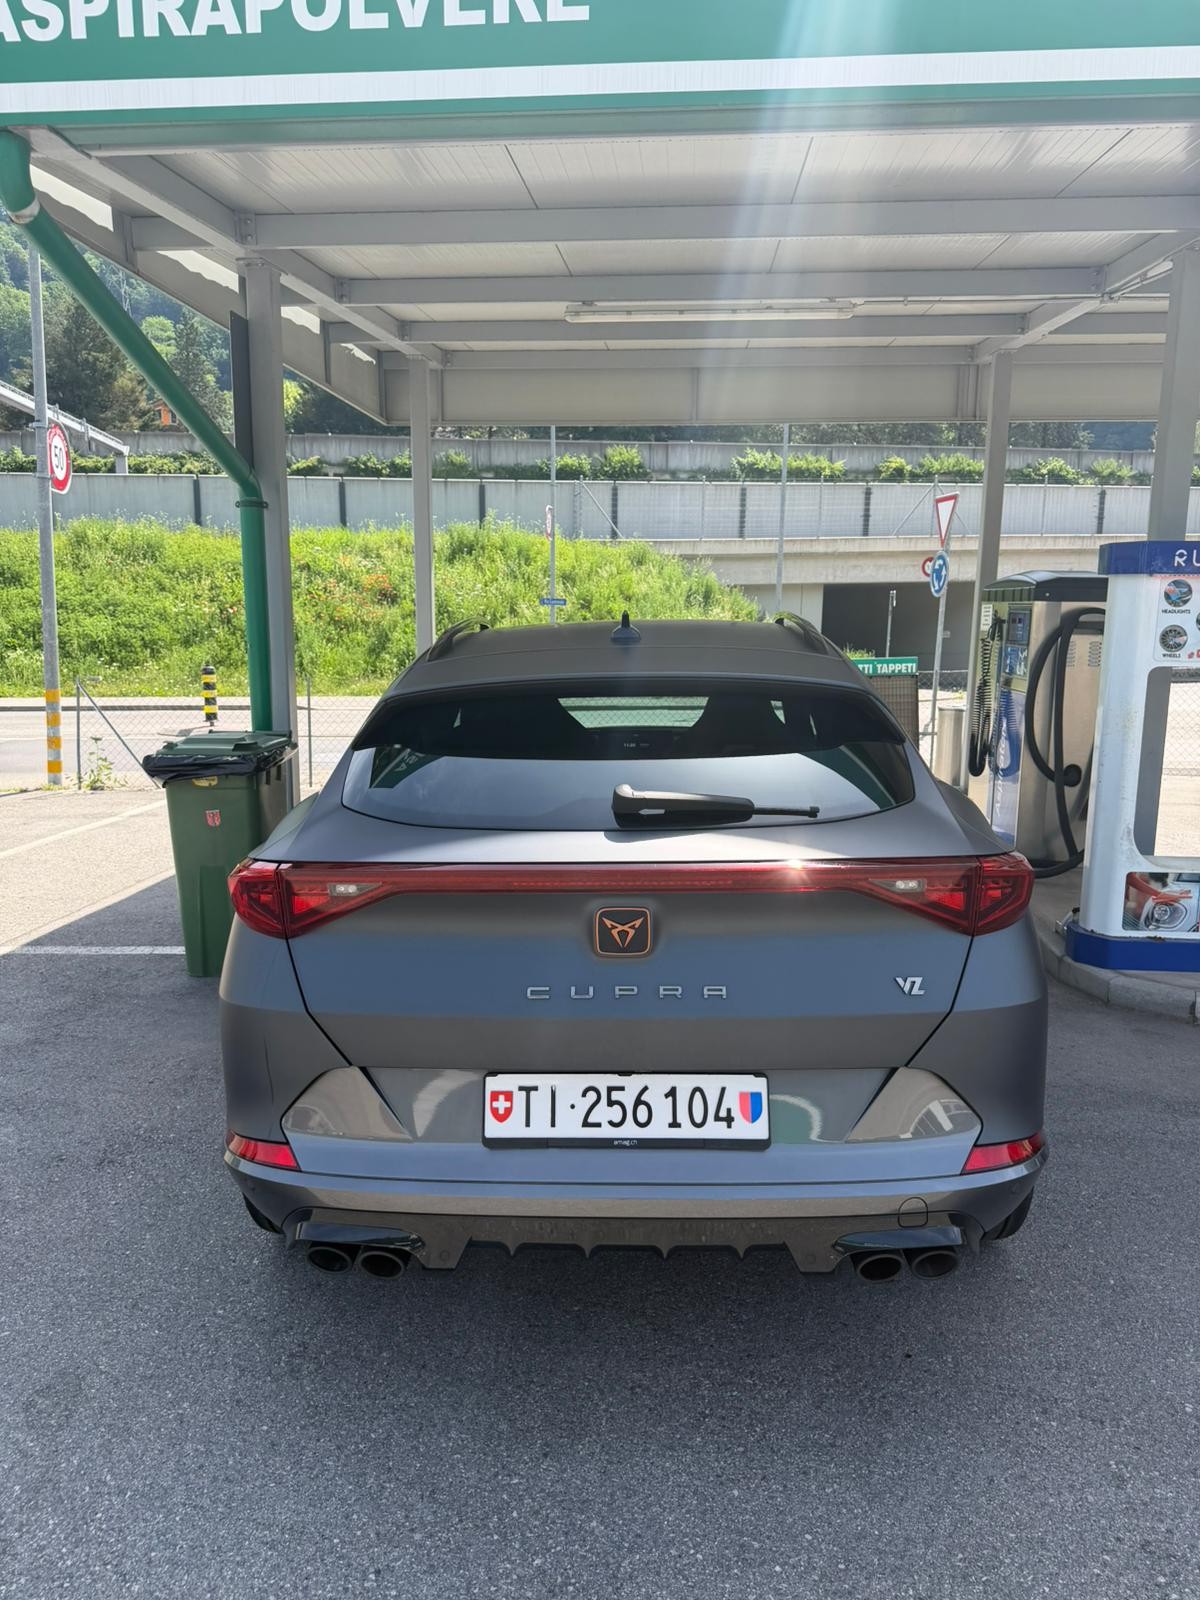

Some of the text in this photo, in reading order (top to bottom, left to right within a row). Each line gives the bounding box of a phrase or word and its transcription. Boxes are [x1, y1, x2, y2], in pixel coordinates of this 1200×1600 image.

[53, 444, 64, 471] 50
[876, 662, 917, 674] TAPPETI
[526, 985, 727, 999] CUPRA
[895, 976, 926, 995] VZ
[613, 1139, 638, 1147] amag.ch
